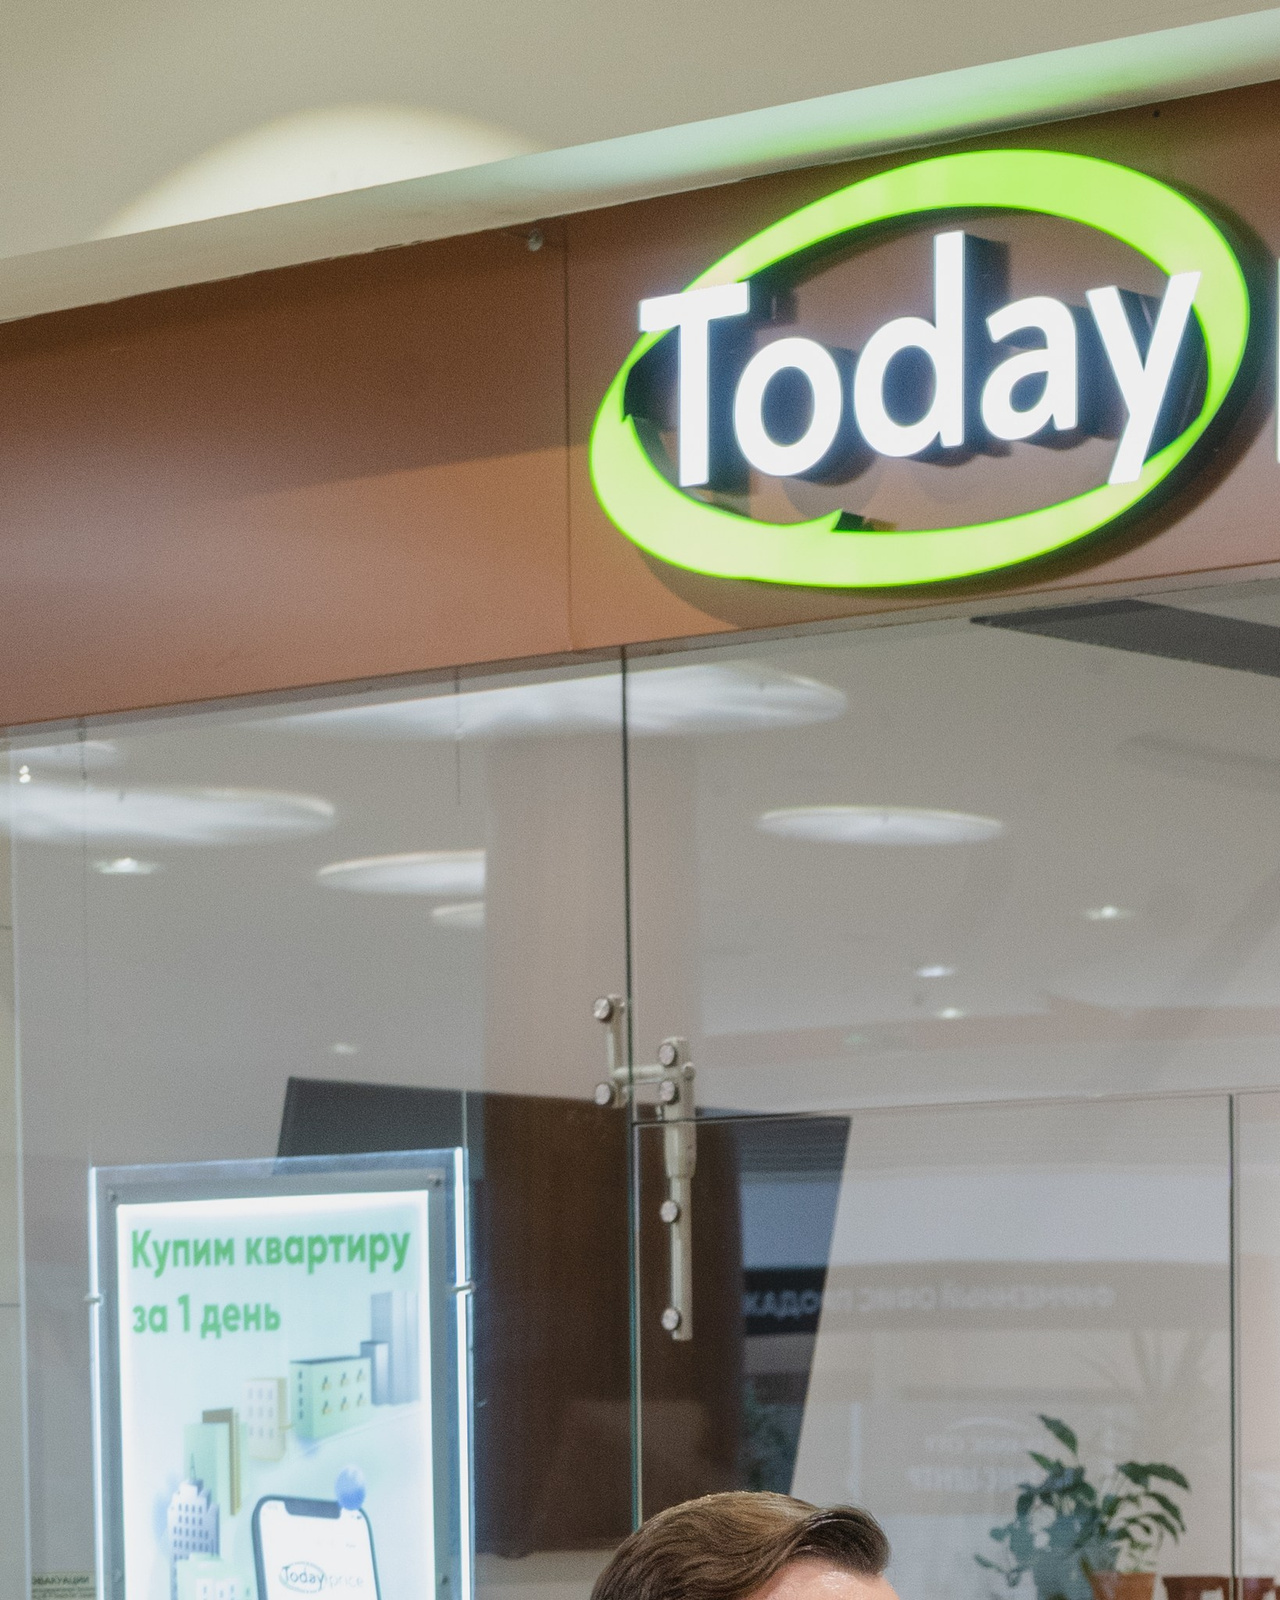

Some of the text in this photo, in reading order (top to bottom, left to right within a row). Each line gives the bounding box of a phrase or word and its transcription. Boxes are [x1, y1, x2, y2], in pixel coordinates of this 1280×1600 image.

[639, 230, 1203, 487] Today
[132, 1229, 411, 1278] Купим квартиру
[132, 1294, 281, 1339] за 1 день
